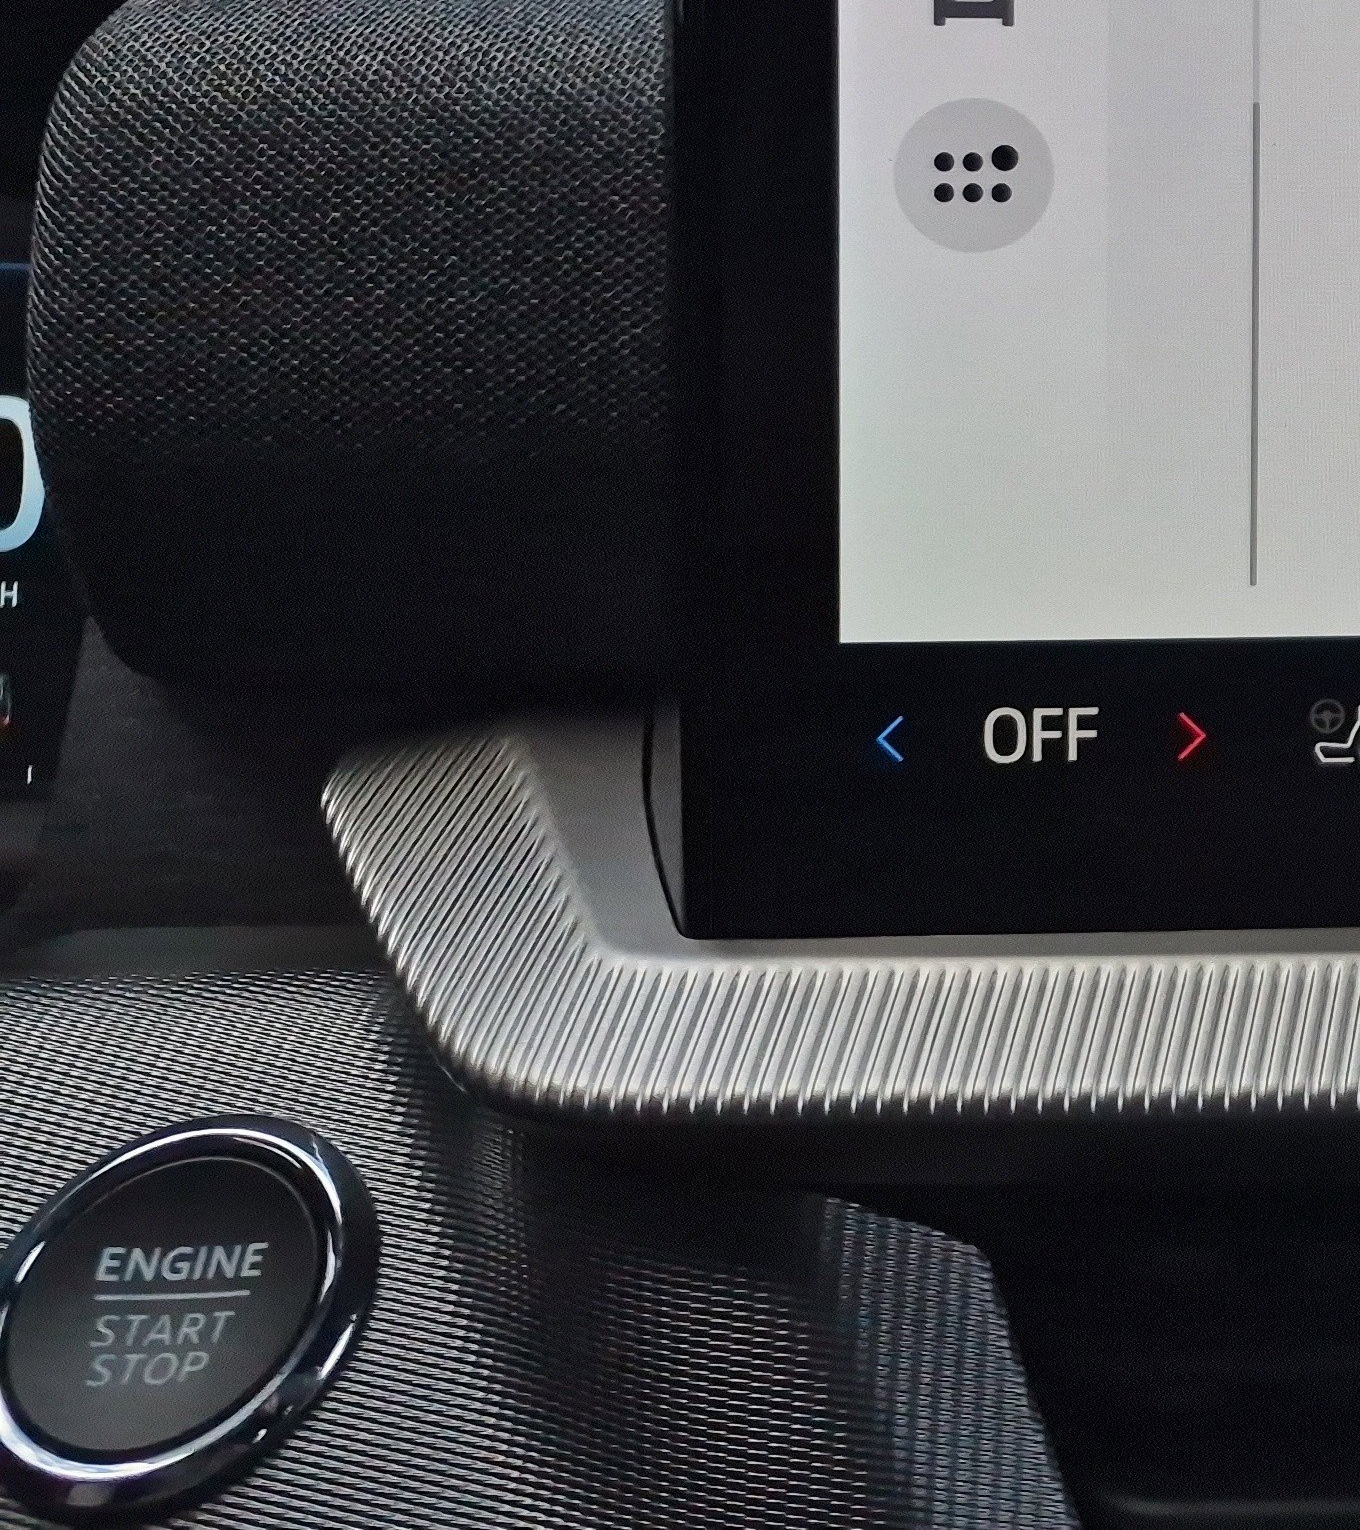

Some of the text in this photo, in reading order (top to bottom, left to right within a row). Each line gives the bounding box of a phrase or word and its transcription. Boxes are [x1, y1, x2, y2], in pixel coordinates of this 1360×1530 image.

[985, 708, 1098, 763] OFF
[95, 1242, 268, 1281] ENGINE
[91, 1311, 234, 1347] START
[87, 1352, 208, 1386] STOP
